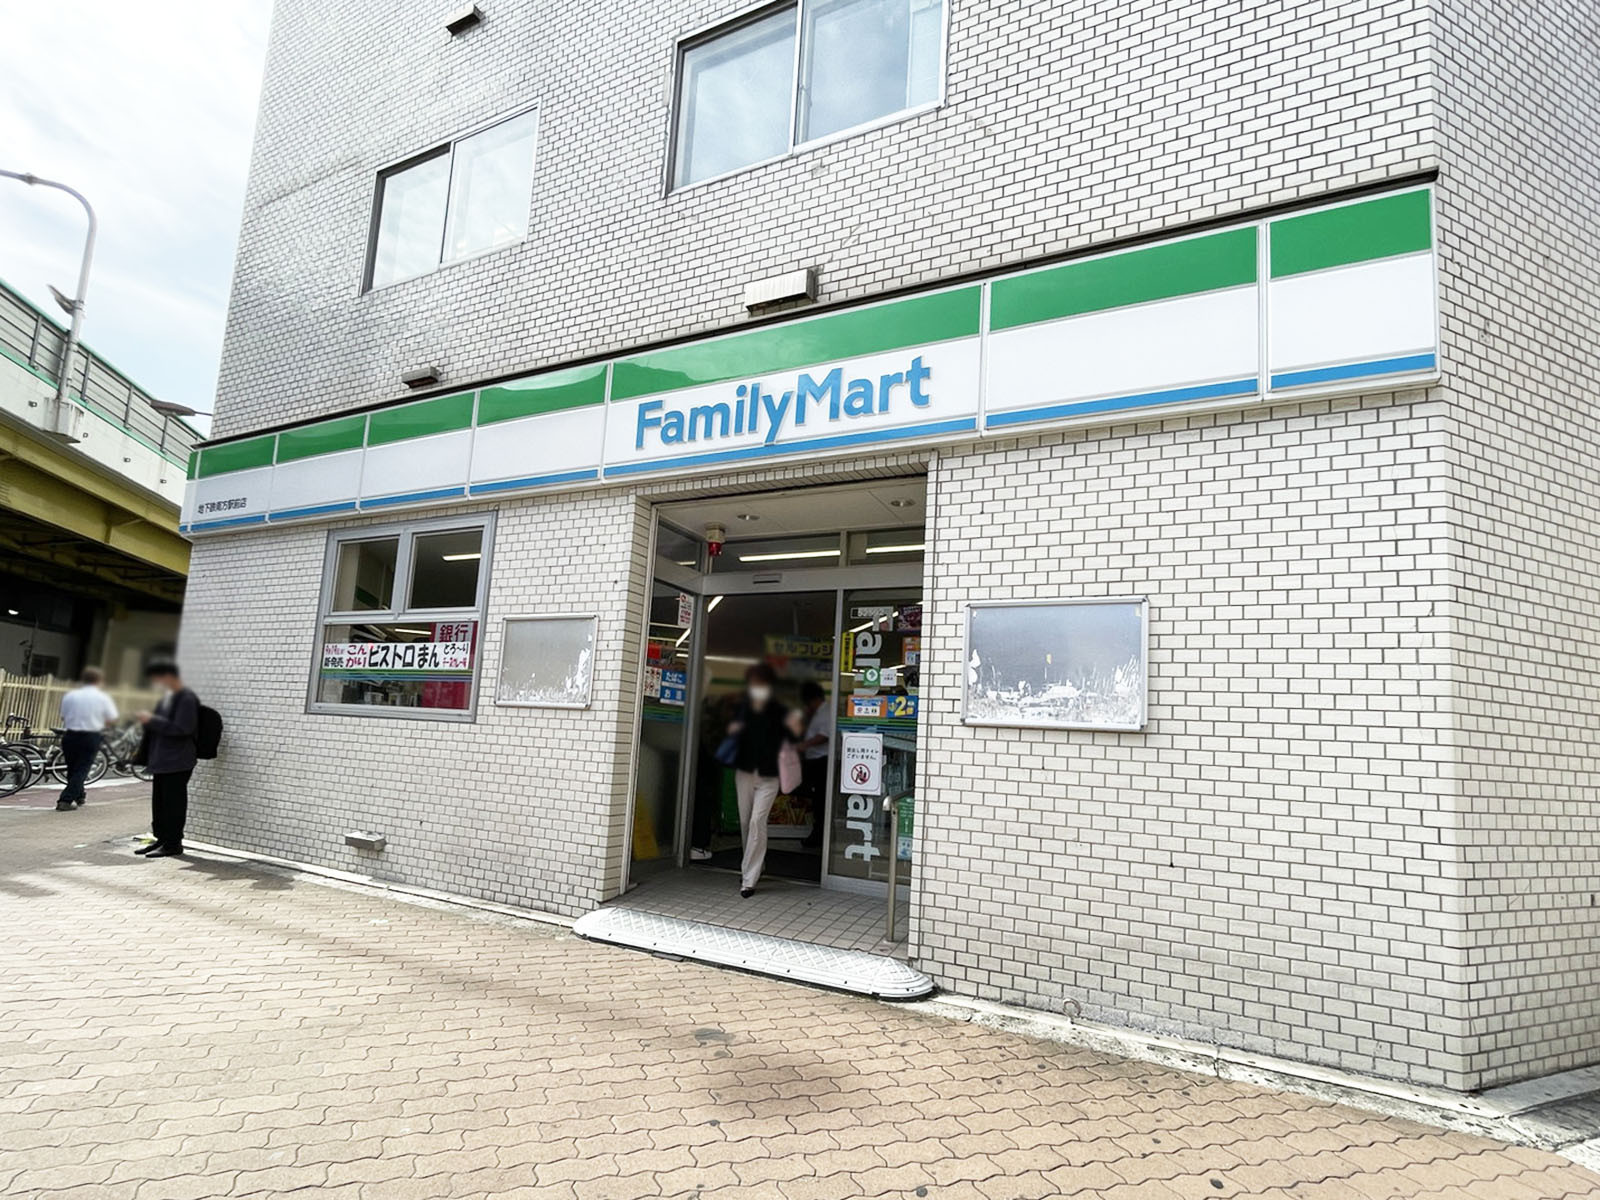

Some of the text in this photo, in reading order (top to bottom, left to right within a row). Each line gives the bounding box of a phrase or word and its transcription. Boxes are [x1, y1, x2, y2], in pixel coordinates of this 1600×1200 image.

[635, 355, 931, 450] FamilyMart
[439, 623, 469, 642] 銀行
[347, 644, 367, 656] こん
[368, 645, 440, 668] ビストロまん
